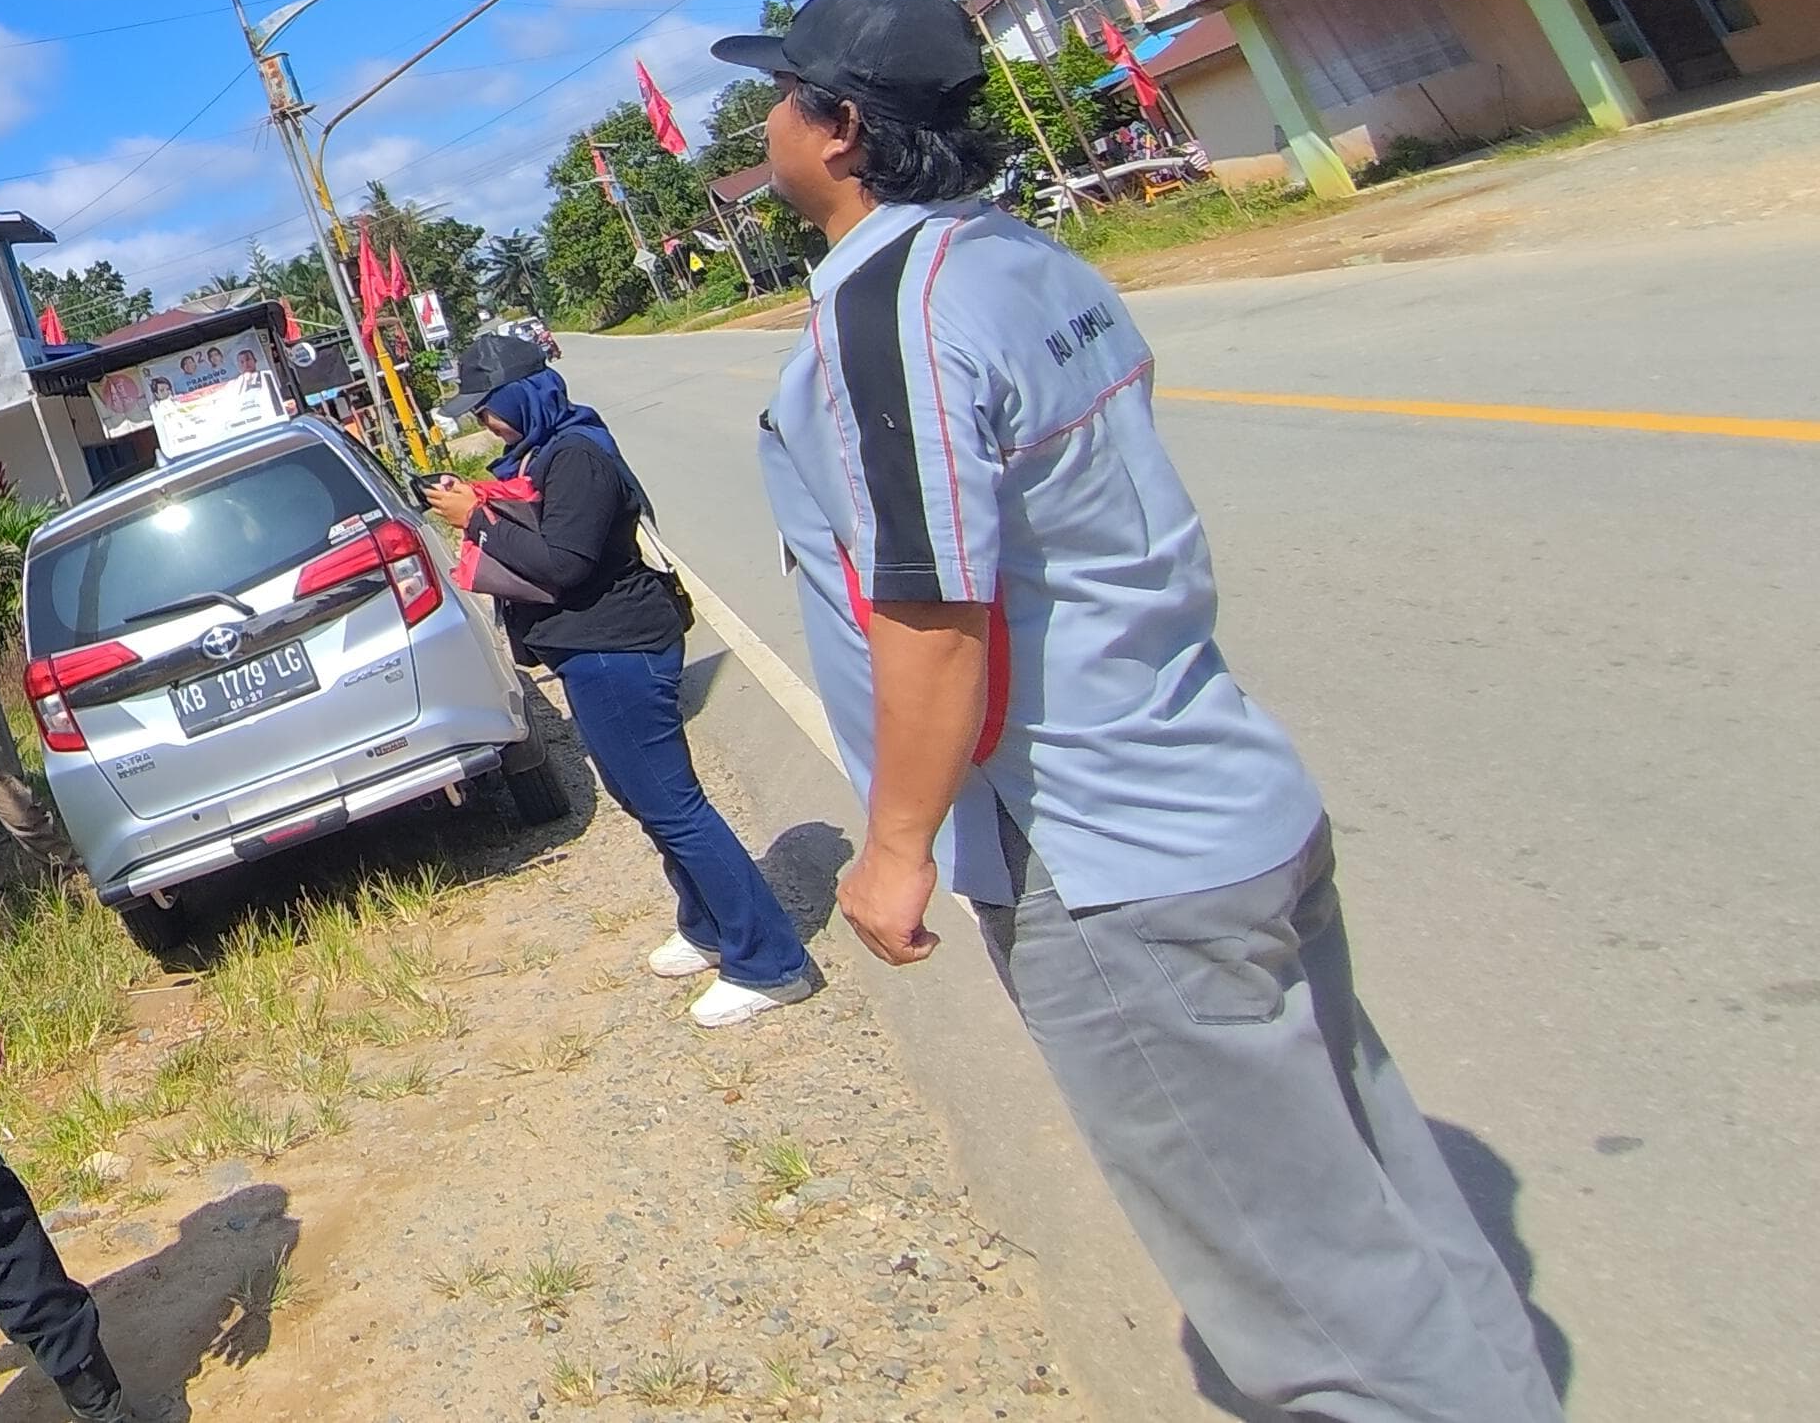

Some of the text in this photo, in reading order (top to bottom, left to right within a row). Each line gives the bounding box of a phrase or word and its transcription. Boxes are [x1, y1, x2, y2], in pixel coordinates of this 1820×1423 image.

[186, 369, 227, 386] PRABOWO
[177, 647, 302, 715] KB 1779 LG
[115, 752, 152, 771] ASTRA
